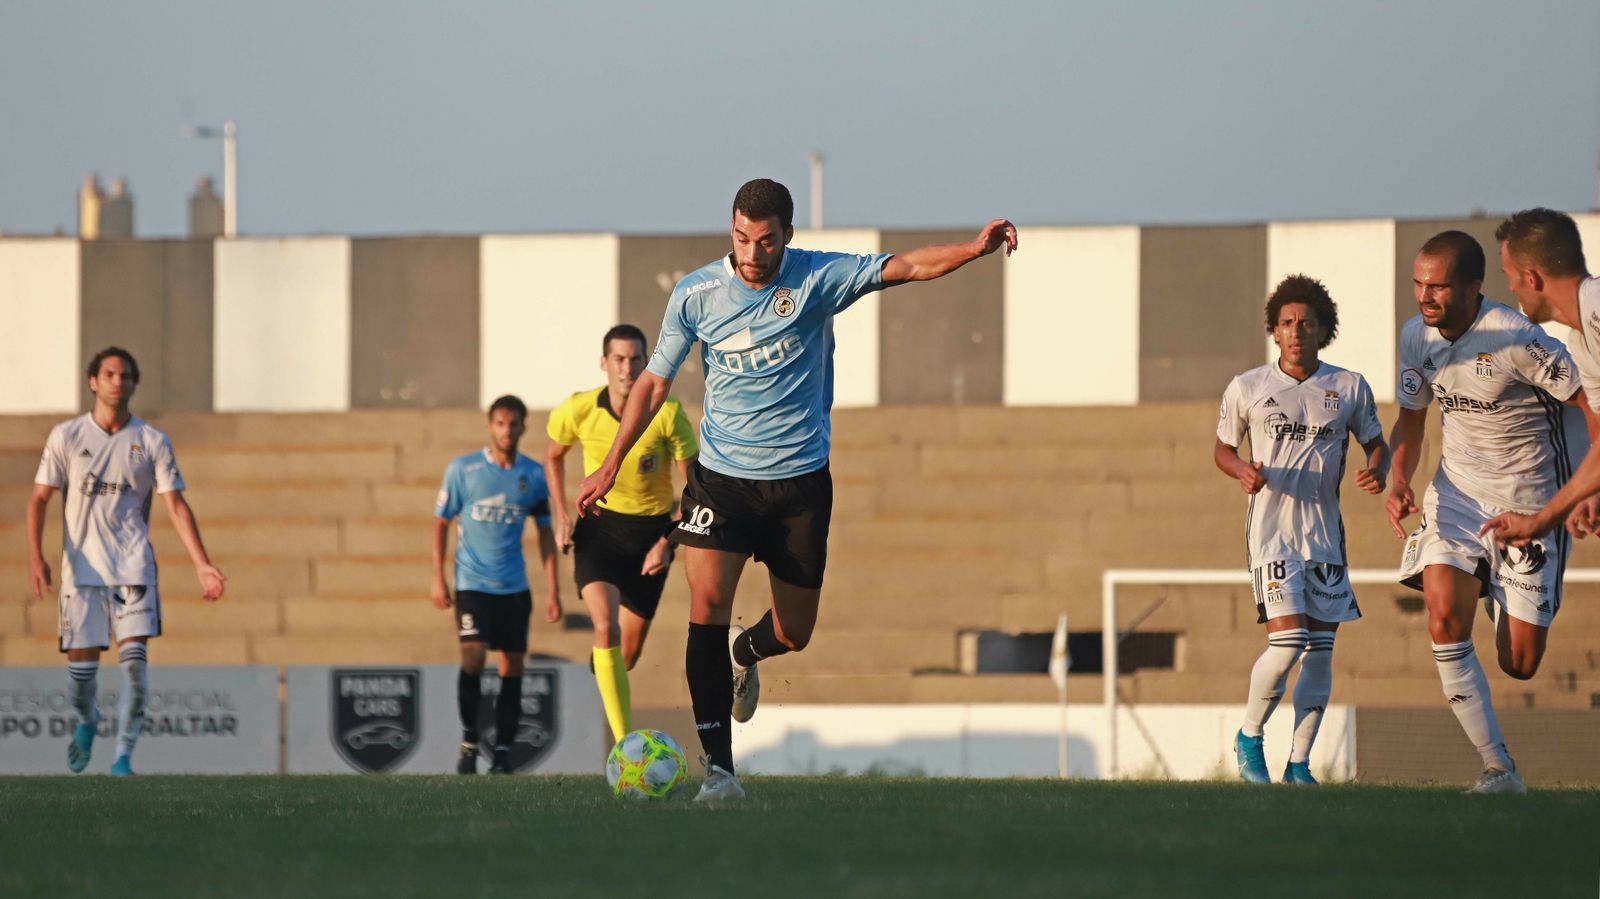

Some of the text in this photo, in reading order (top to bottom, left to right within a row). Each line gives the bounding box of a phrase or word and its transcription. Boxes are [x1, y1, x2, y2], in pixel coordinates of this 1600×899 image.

[686, 278, 722, 295] LEGEA
[689, 505, 714, 528] 10
[678, 521, 711, 536] LEGEA
[1267, 560, 1286, 580] 18
[340, 676, 411, 698] PANDA
[353, 698, 400, 717] CARS
